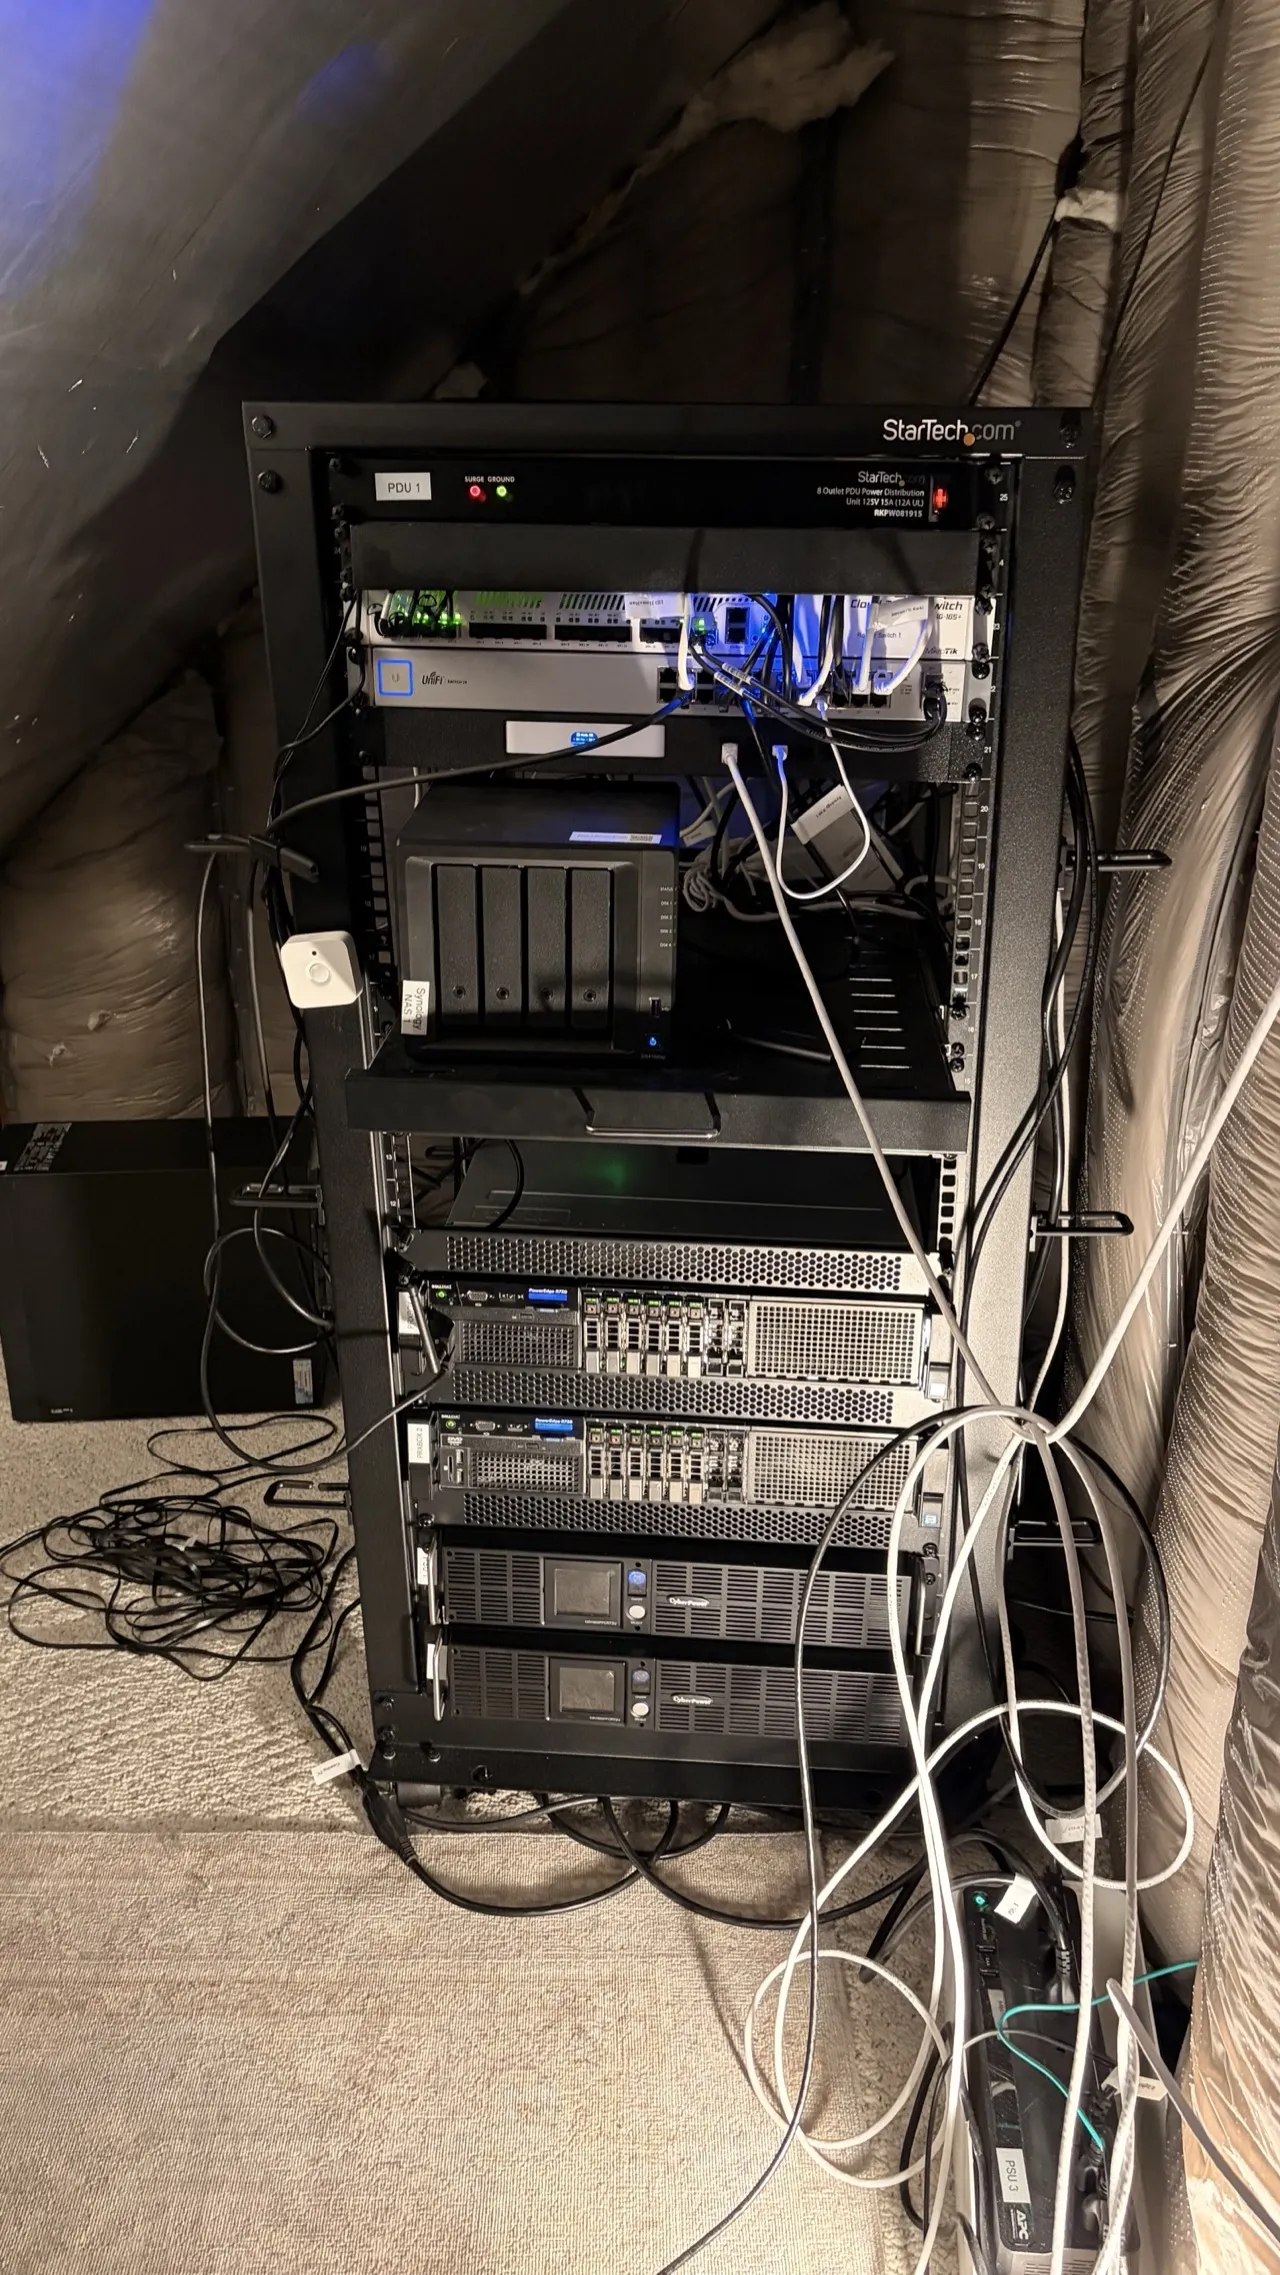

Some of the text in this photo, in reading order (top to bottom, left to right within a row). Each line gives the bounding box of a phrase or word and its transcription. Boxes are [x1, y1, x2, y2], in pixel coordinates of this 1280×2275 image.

[464, 475, 485, 483] SURGE
[487, 475, 515, 483] GROUND
[388, 482, 421, 493] PDU 1
[817, 487, 925, 497] 8 Outlet PDU Power Distribution
[846, 498, 924, 507] Unit 125V 15A (12A UL)
[874, 509, 923, 517] RKPW081915
[934, 601, 963, 610] witch
[422, 672, 443, 685] UniFi
[403, 993, 413, 1015] NAS
[413, 987, 426, 1031] Synology
[528, 1287, 555, 1295] PowerEdge
[668, 1597, 709, 1608] CyberPower
[672, 1695, 712, 1706] CyberPower
[1005, 2159, 1019, 2193] PSU 3
[1016, 2209, 1029, 2241] APC
